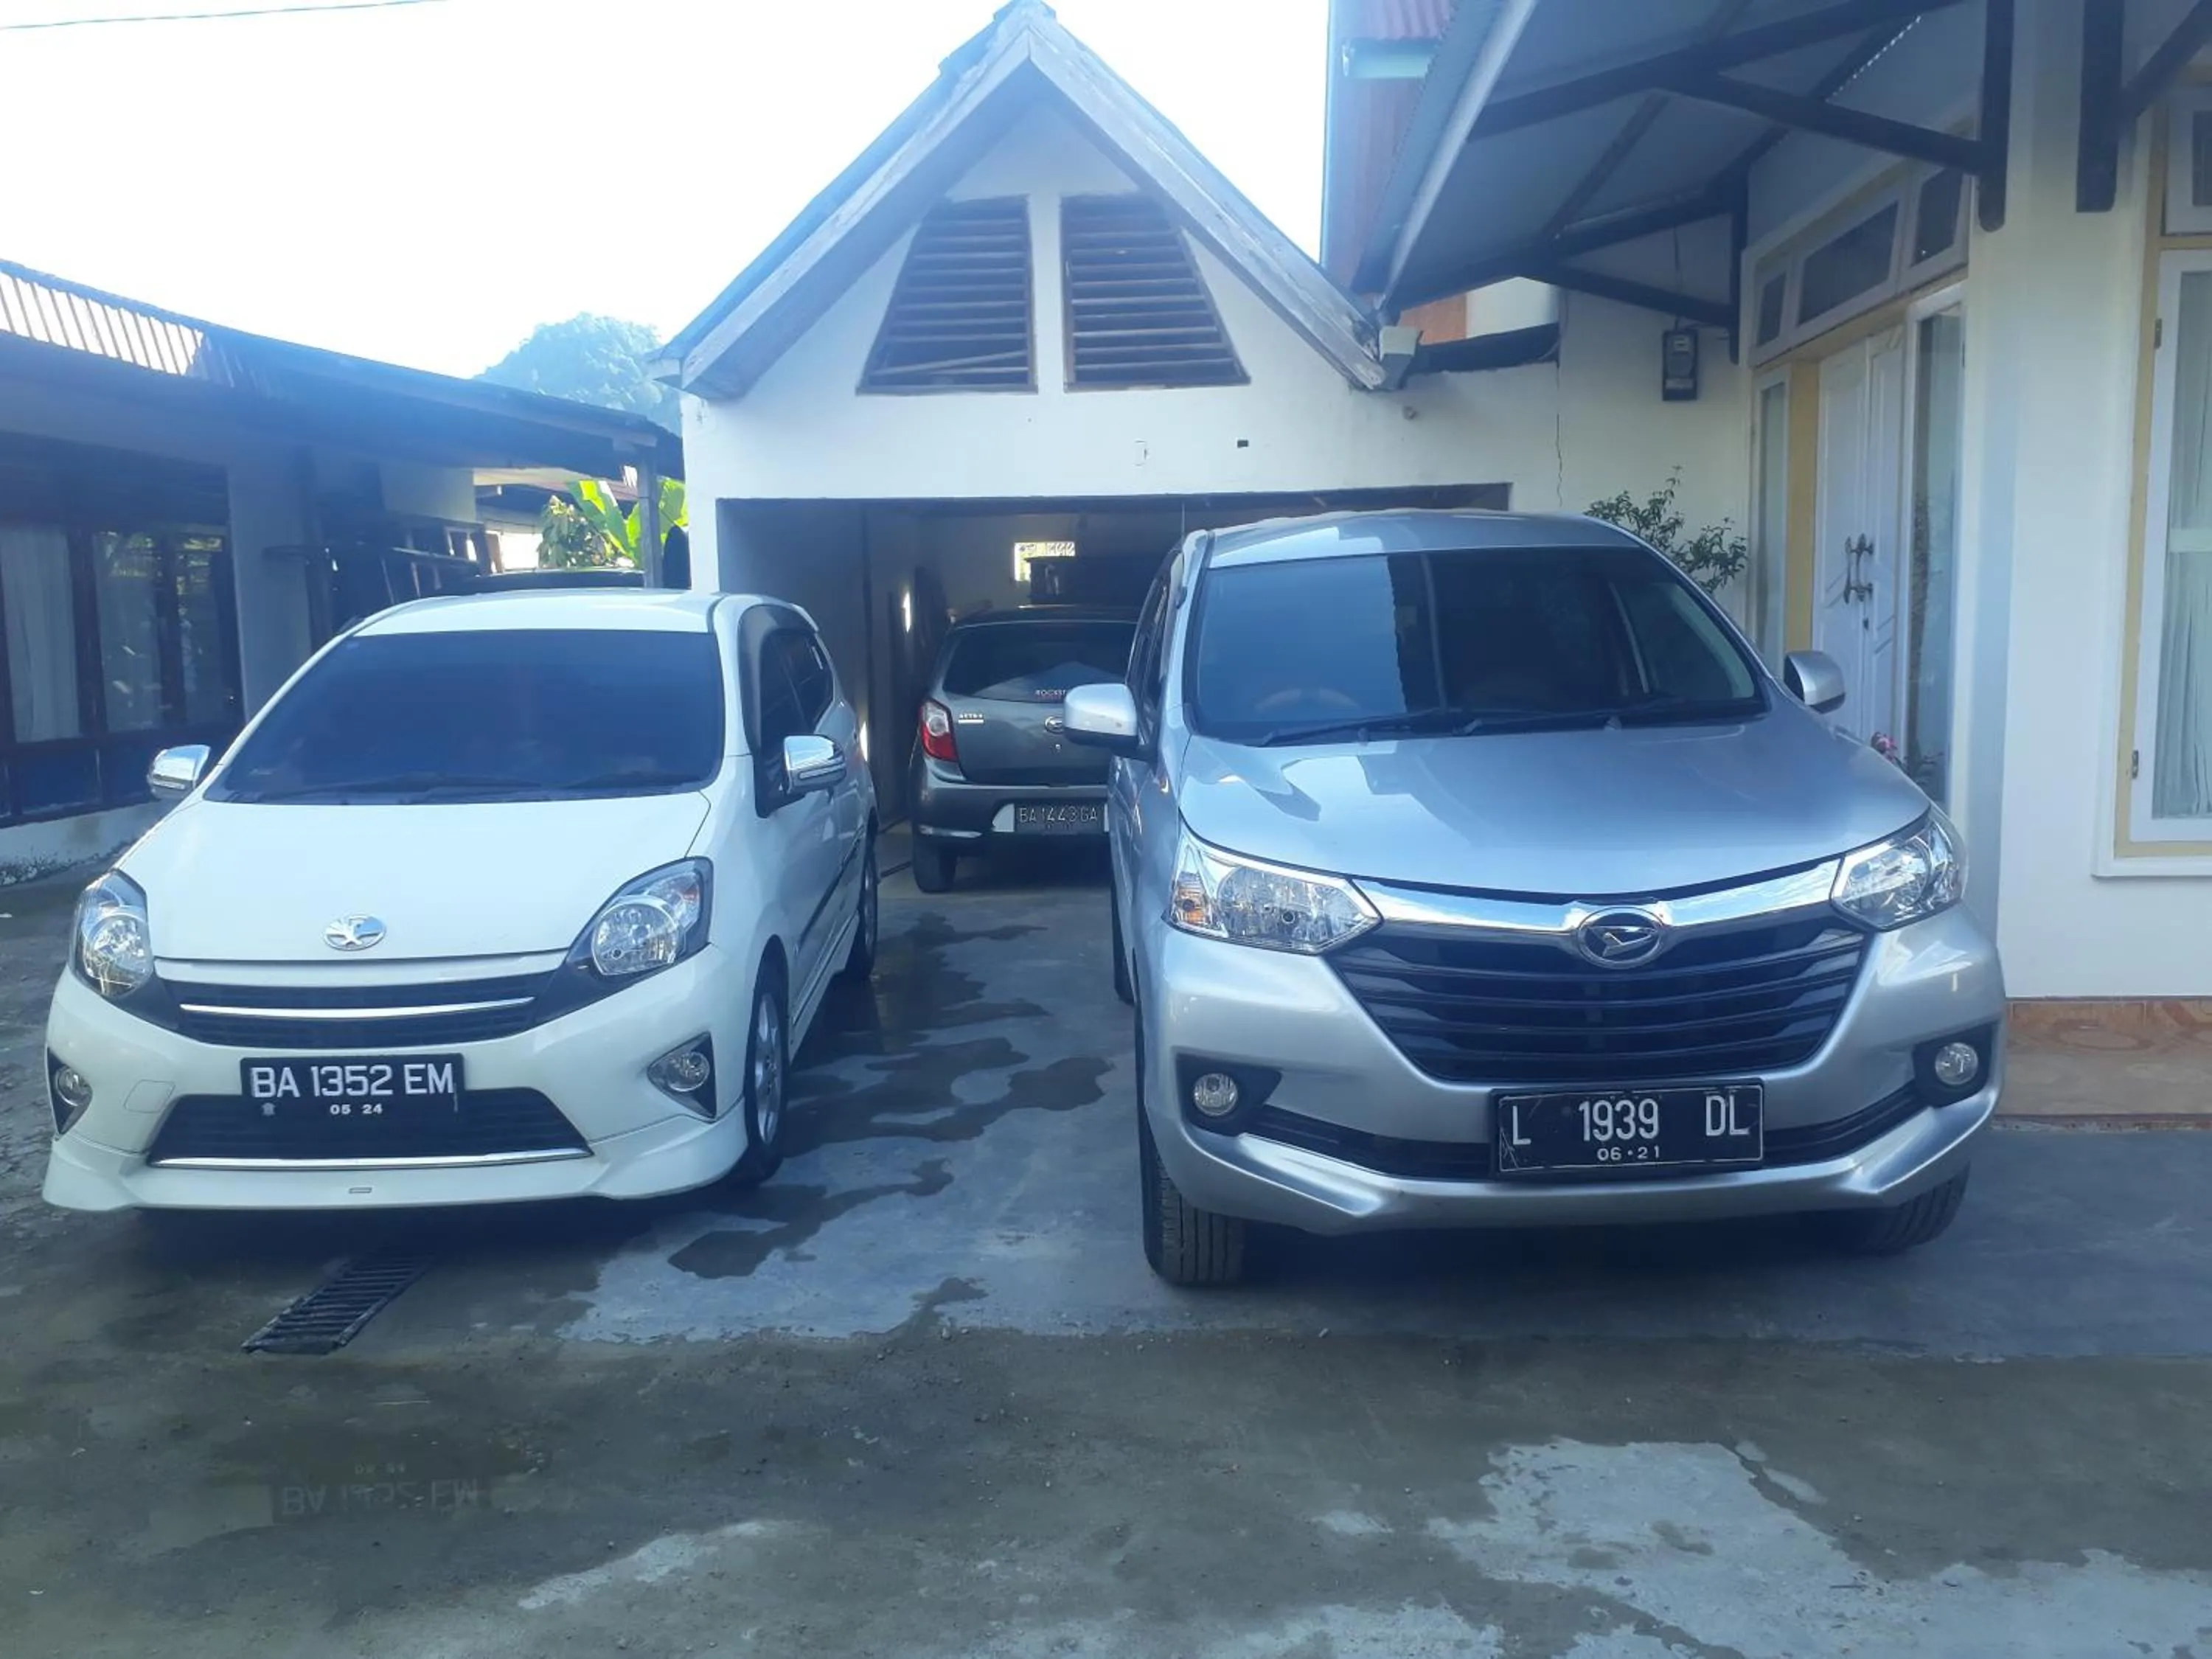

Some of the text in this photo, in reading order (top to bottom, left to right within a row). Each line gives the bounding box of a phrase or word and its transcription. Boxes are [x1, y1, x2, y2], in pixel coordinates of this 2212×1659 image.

[251, 1062, 454, 1098] BA 1352 EM
[330, 1103, 383, 1115] 05 24
[1512, 1095, 1750, 1145] L 1939 DL
